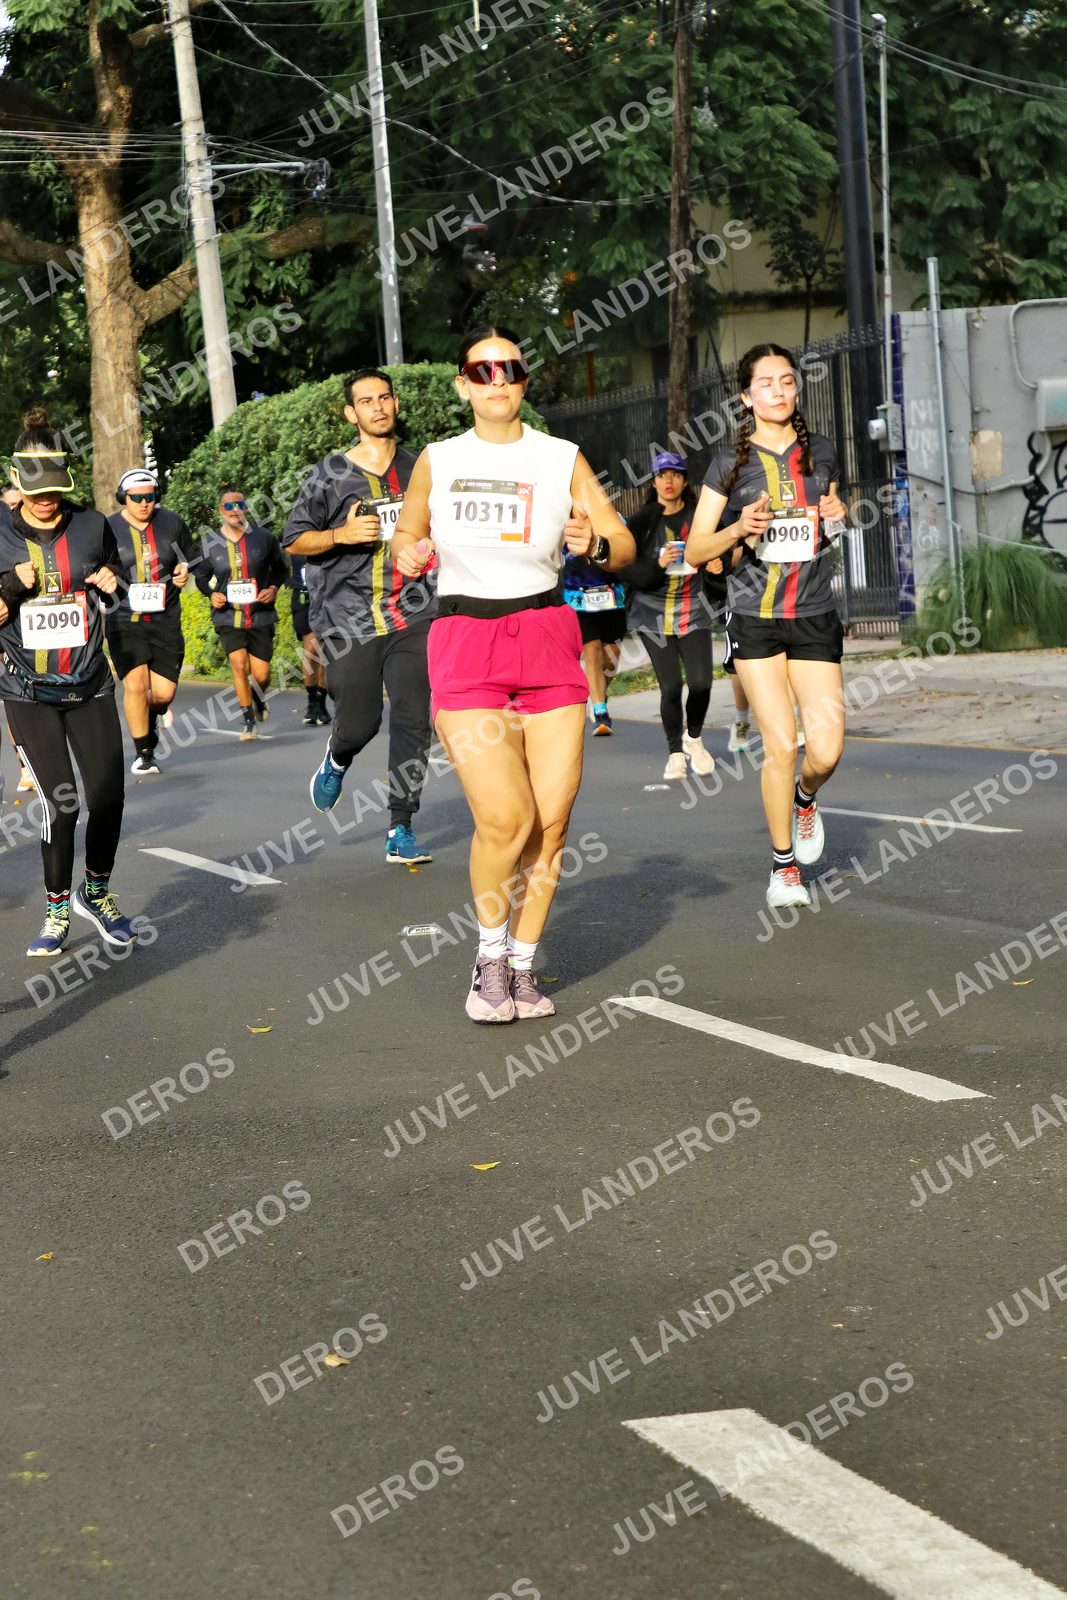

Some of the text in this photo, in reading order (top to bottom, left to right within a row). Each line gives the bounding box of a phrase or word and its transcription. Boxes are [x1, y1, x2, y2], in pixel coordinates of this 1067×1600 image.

[381, 509, 400, 524] 10
[453, 500, 518, 524] 10311
[25, 610, 80, 631] 12090
